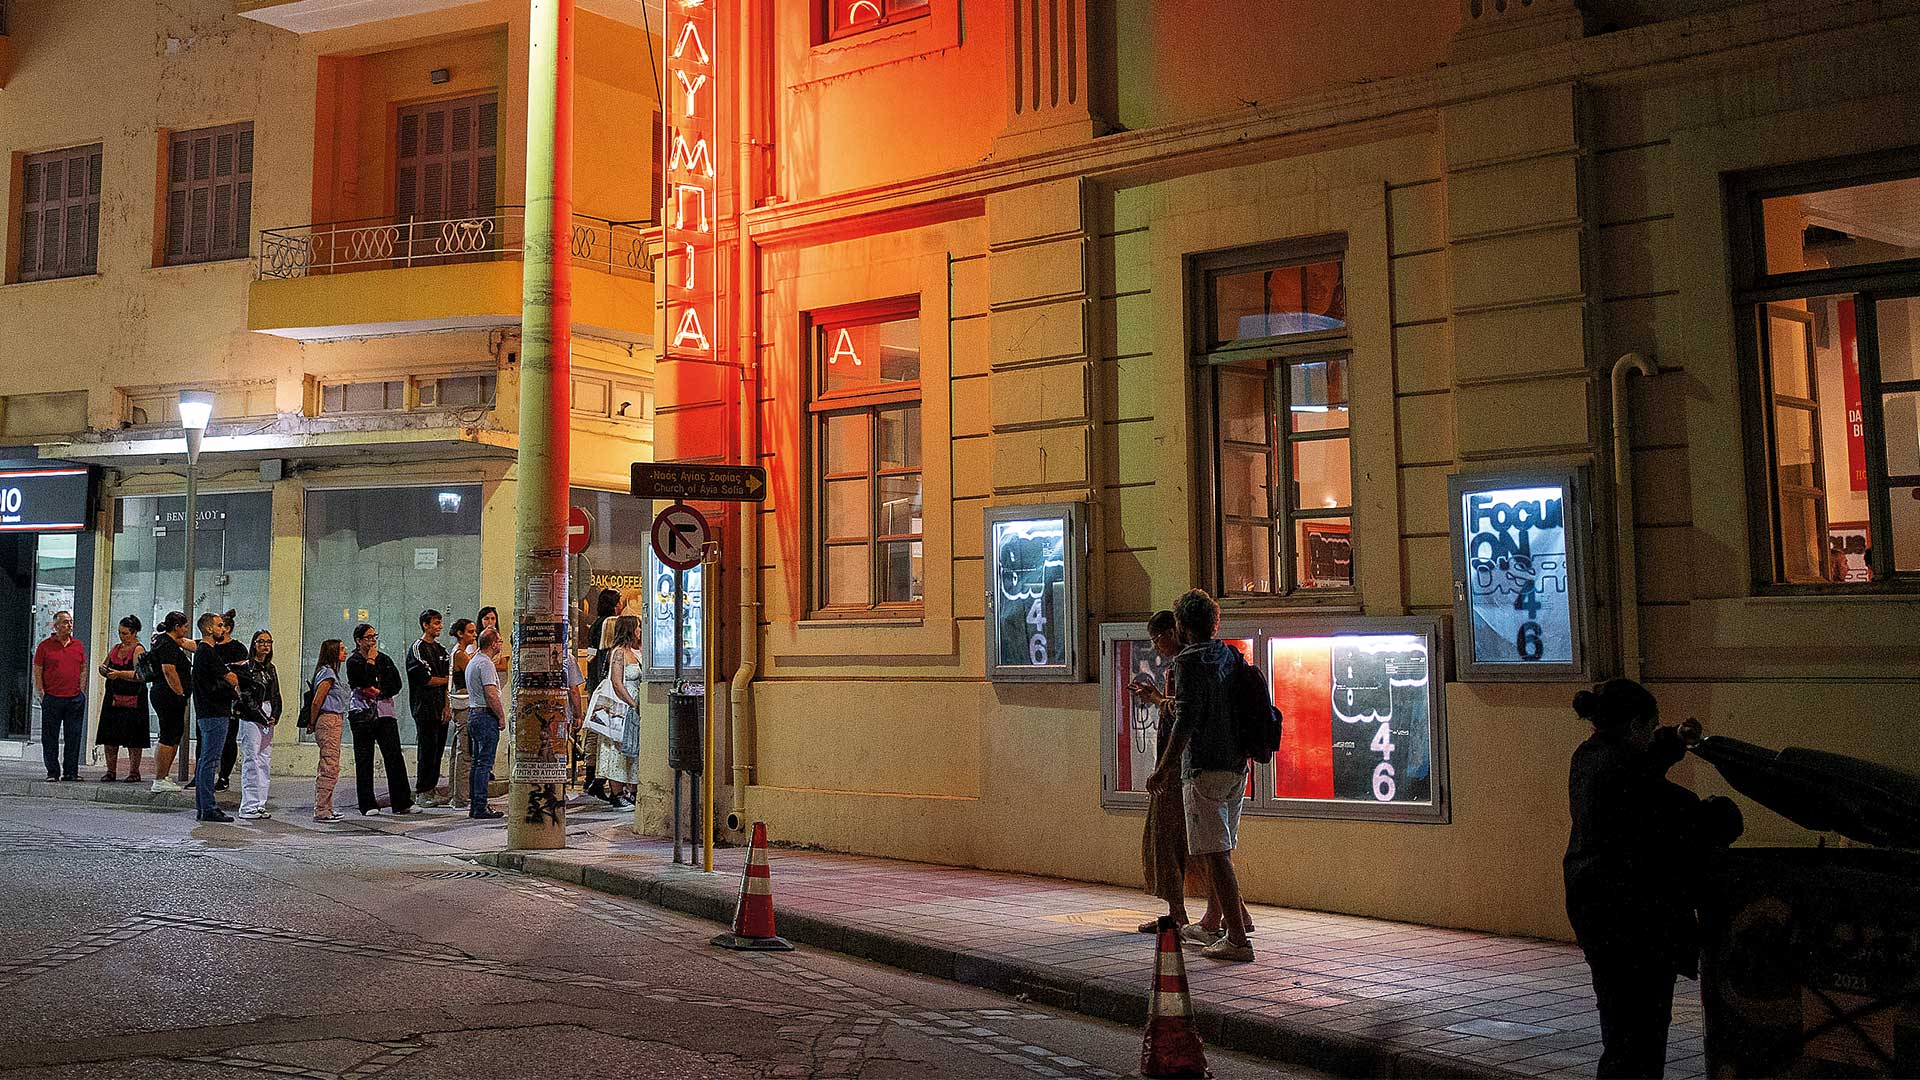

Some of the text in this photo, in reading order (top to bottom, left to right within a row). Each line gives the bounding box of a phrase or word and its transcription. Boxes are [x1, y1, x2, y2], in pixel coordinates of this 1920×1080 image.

[668, 0, 714, 352] ΛΥΜΠΙΑ
[653, 470, 741, 484] Ναός Αγίας Σοφίας
[653, 482, 744, 497] Church of Ayia Sofia
